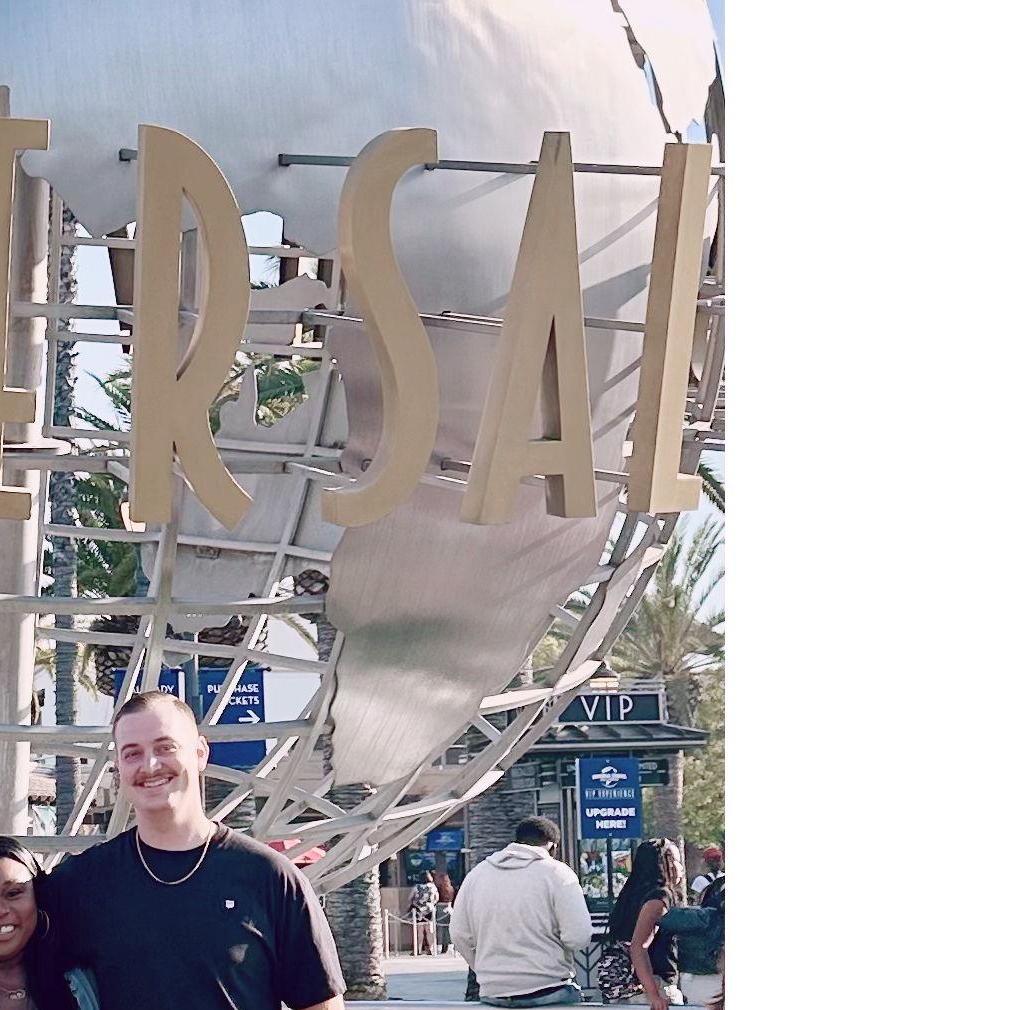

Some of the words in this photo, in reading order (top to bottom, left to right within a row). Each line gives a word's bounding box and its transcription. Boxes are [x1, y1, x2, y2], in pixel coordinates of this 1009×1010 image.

[207, 683, 259, 694] PUHASE
[228, 696, 260, 706] CKETS
[580, 695, 634, 721] VIP
[585, 807, 636, 817] UPGRADE
[595, 819, 627, 829] HERE!
